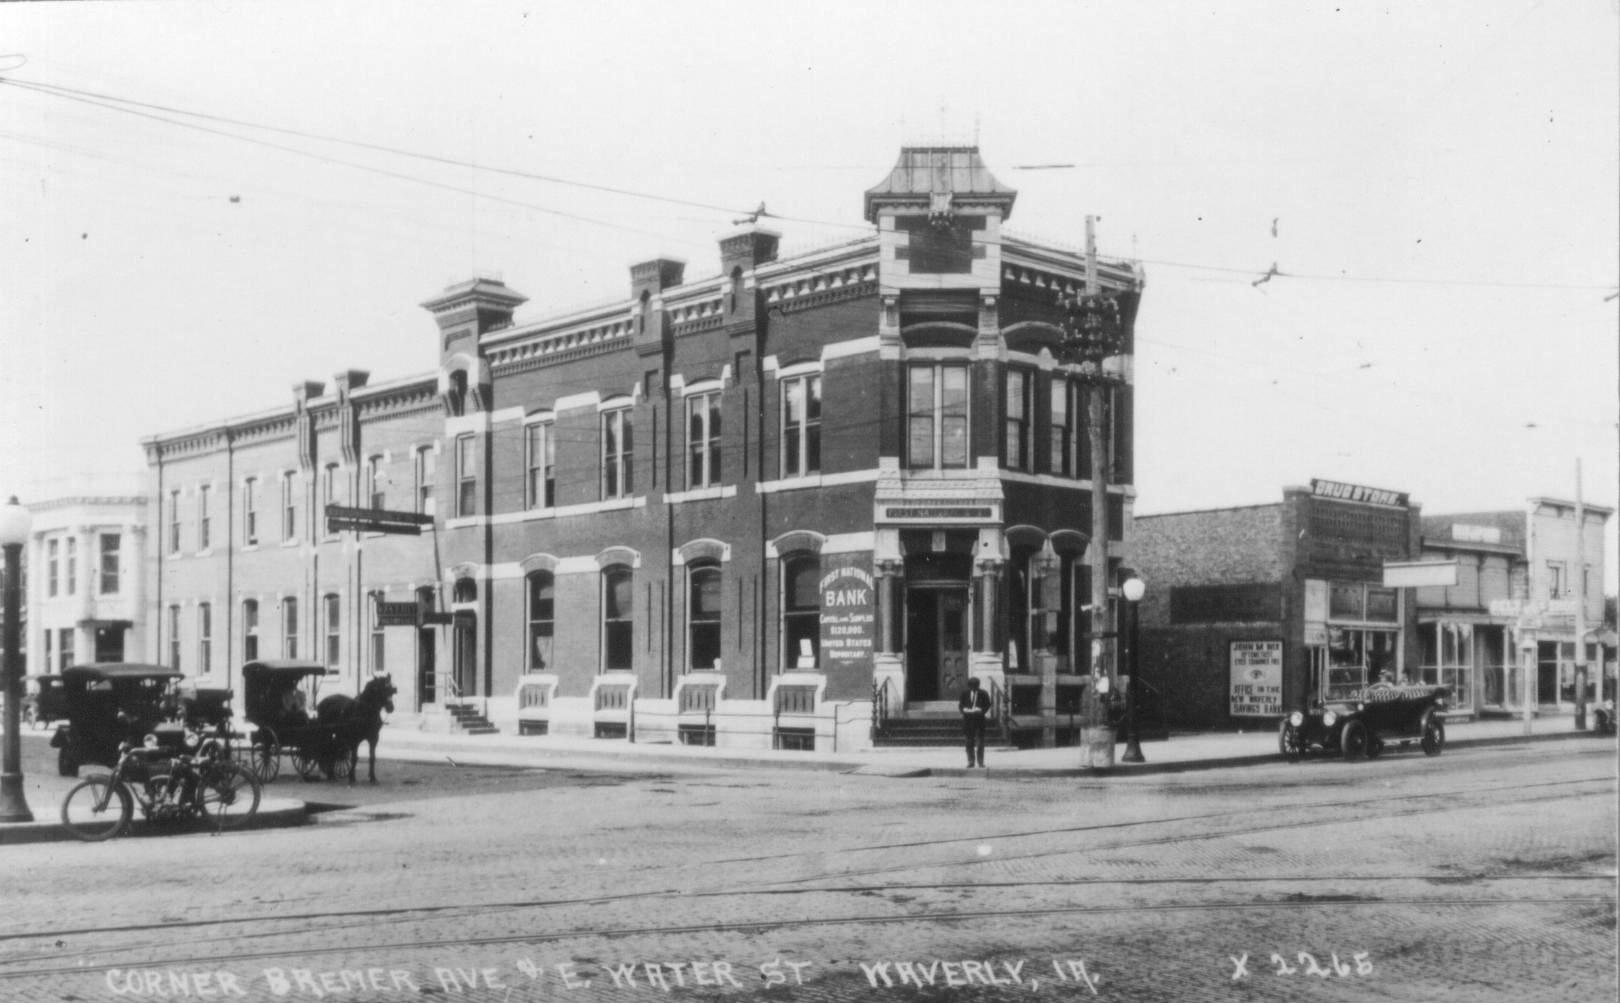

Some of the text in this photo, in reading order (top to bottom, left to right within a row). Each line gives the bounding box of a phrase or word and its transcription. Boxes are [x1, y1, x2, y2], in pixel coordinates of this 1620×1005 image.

[1315, 480, 1353, 499] DRUG
[819, 568, 840, 594] FIRST
[825, 588, 867, 607] BANK
[1233, 704, 1260, 713] SAVINGS
[1249, 696, 1277, 704] WAVERLY
